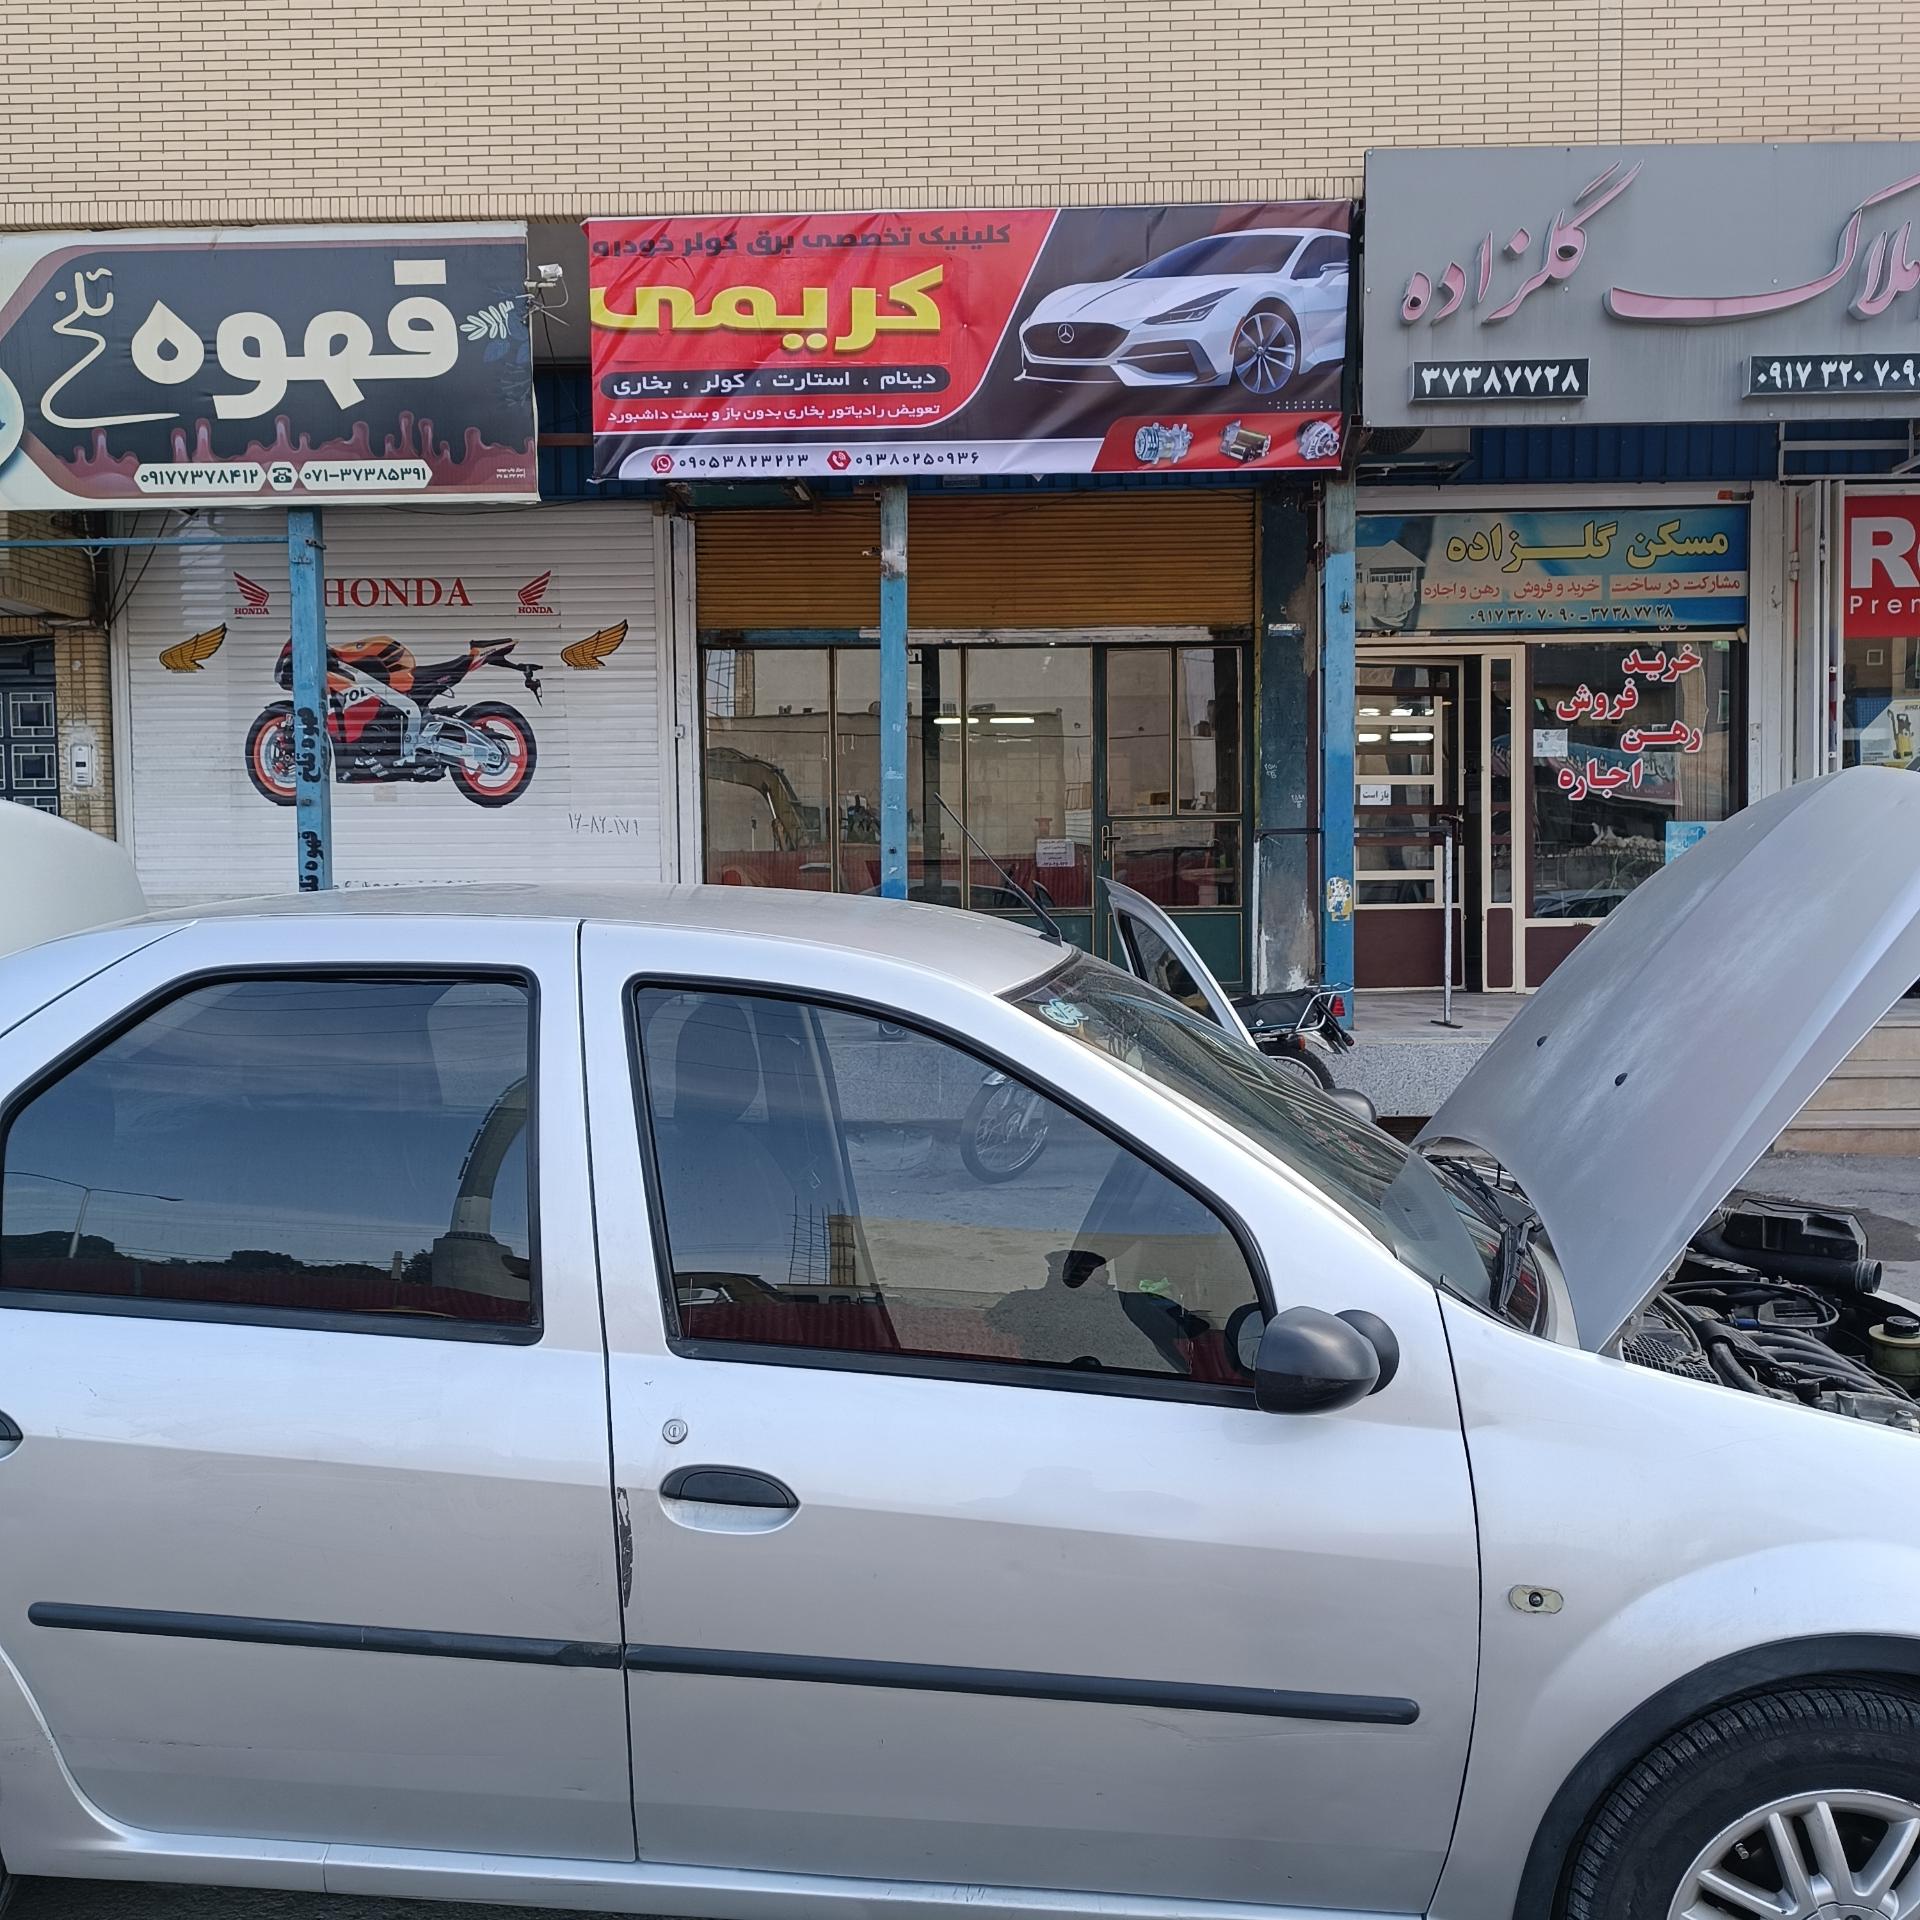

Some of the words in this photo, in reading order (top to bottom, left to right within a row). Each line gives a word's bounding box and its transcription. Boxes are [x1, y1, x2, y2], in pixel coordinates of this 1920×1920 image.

[592, 234, 674, 257] خودرو
[682, 232, 738, 257] کولر
[746, 231, 795, 257] برق
[802, 227, 913, 249] تخصصی
[918, 224, 1011, 250] کلینیک
[1401, 160, 1644, 325] گلزاده
[1604, 172, 1920, 323] ملاک
[589, 264, 944, 353] کریمی
[41, 268, 180, 428] تلخ
[131, 259, 459, 420] قهوه
[700, 373, 746, 393] کولر
[772, 371, 850, 391] استارت
[880, 371, 937, 390] دینام
[1421, 364, 1580, 395] ۳۷۳۸۷۷۲۸
[1757, 361, 1812, 389] ۰۹۱۷
[1820, 360, 1864, 388] ۳۲۰
[1873, 359, 1920, 387] ۷۰۹
[613, 375, 672, 396] بخاری
[608, 409, 669, 424] داشبورد
[671, 409, 709, 421] بست
[711, 410, 720, 422] و
[722, 407, 740, 421] باز
[743, 407, 781, 420] بدون
[784, 405, 825, 420] بخاری
[827, 405, 884, 419] رادیاتور
[887, 404, 941, 418] تعویض
[679, 454, 809, 469] ۰۹۰۵۳۸۲۳۲۲۳
[855, 451, 980, 466] ۰۹۳۸۰۲۵۰۹۳۶
[140, 469, 259, 485] ۰۹۱۷۷۳۷۸۴۱۲
[304, 467, 427, 482] ۰۷۱-۳۷۳۸۵۳۹۱
[1446, 519, 1618, 573] گلزاده
[1625, 519, 1729, 569] مسکن
[1850, 516, 1920, 588] R
[323, 576, 473, 608] HONDA
[1424, 583, 1457, 599] اجاره
[1459, 587, 1467, 599] و
[1469, 585, 1500, 600] رهن
[1513, 578, 1553, 599] فروش
[1556, 584, 1564, 597] و
[1567, 578, 1600, 598] خرید
[1611, 576, 1662, 593] ساخت
[1664, 578, 1680, 594] در
[1683, 575, 1740, 593] مشارکت
[233, 607, 270, 615] HONDA
[517, 606, 554, 614] HONDA
[1622, 644, 1703, 682] خرید
[1556, 678, 1639, 720] فروش
[1620, 719, 1704, 753] رهن
[1557, 758, 1644, 800] اجاره
